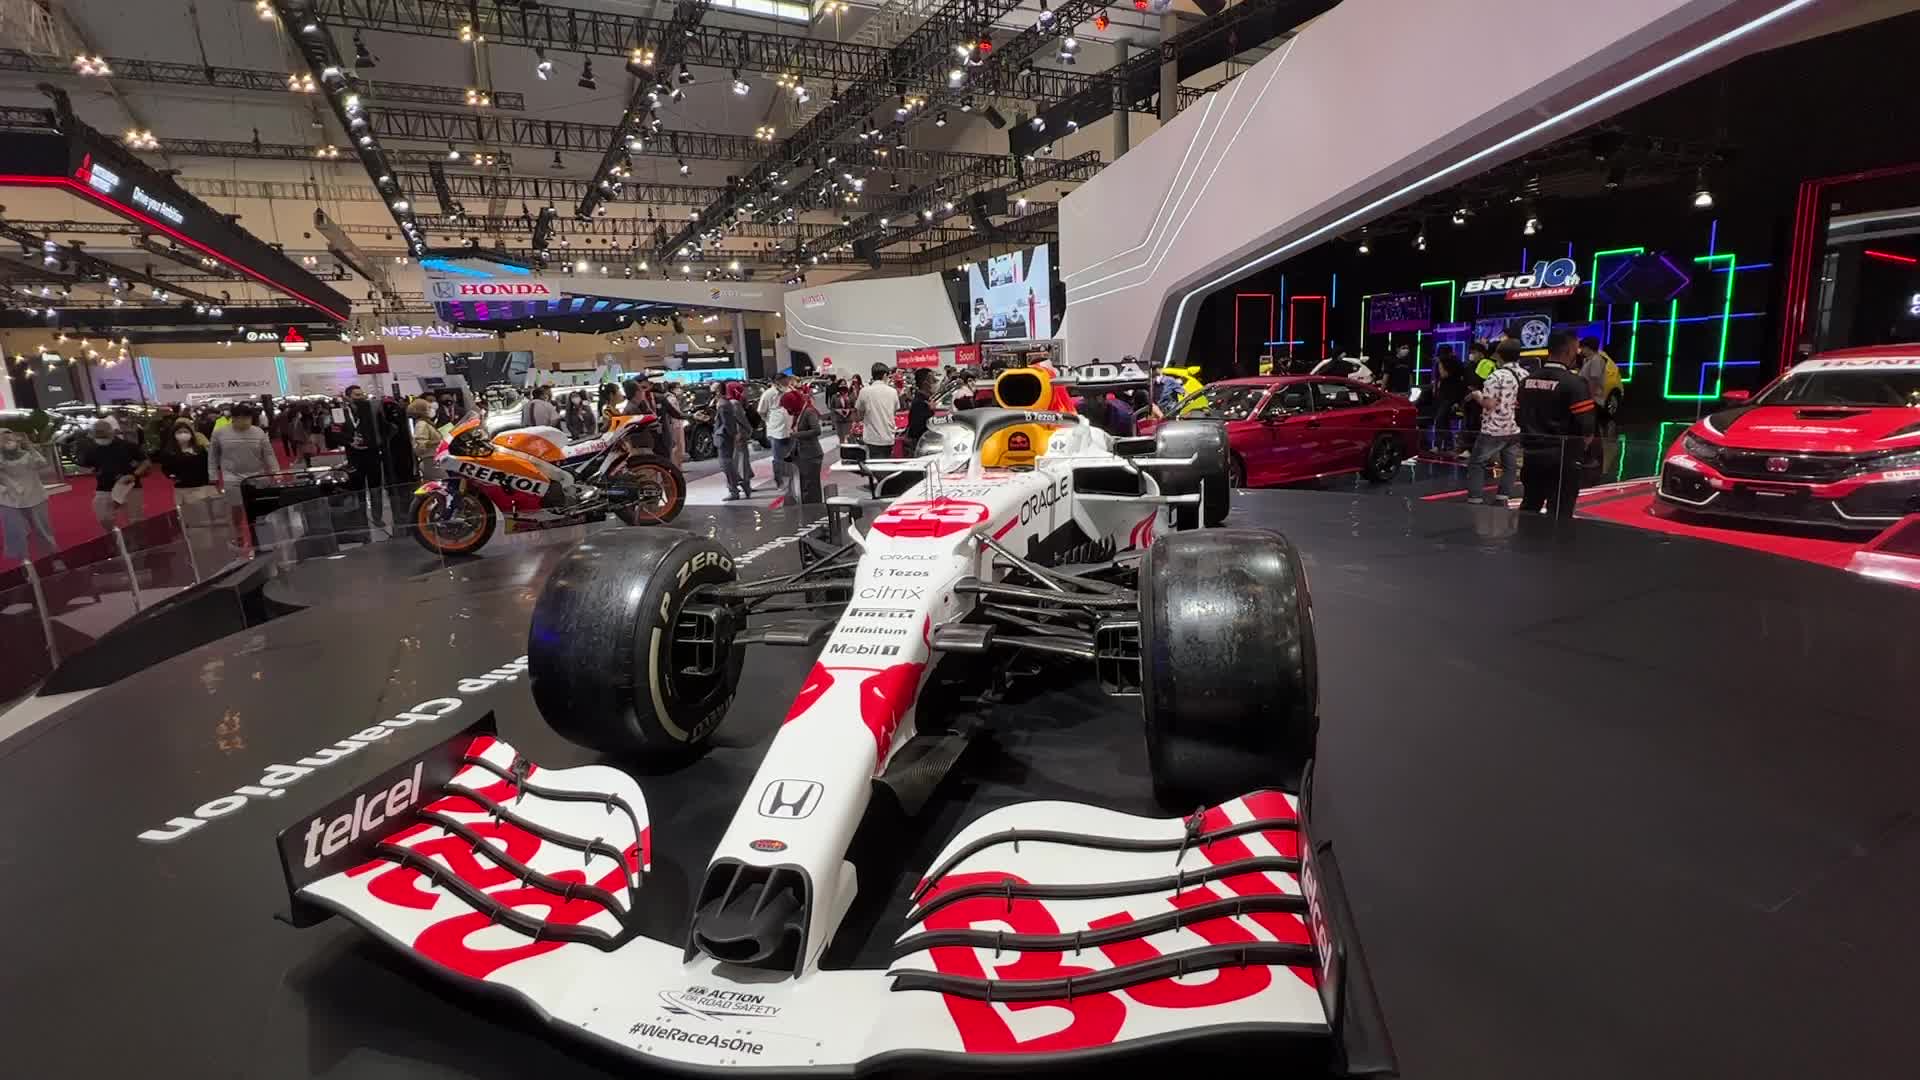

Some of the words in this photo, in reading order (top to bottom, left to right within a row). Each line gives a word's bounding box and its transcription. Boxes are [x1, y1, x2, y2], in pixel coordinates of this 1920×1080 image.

[459, 283, 551, 296] HONDA
[1464, 274, 1536, 293] BRIO
[1511, 288, 1570, 299] ANNIVERSARY
[381, 325, 450, 337] NISSAN
[361, 352, 380, 366] IN
[458, 462, 544, 495] REPSOL
[1020, 476, 1069, 526] ORACLE
[889, 568, 929, 577] Tezos
[660, 592, 671, 624] P
[676, 551, 733, 589] ZERO
[860, 585, 925, 600] citrix
[849, 607, 916, 619] PIRELLI
[840, 626, 908, 636] infinitum
[829, 643, 881, 656] Mobil
[137, 697, 464, 842] Champion
[303, 761, 425, 868] telcel
[708, 989, 765, 1004] ACTION
[697, 998, 734, 1010] ROAD
[732, 1002, 782, 1015] SAFETY
[629, 1022, 764, 1055] #WeRaceAsOne
